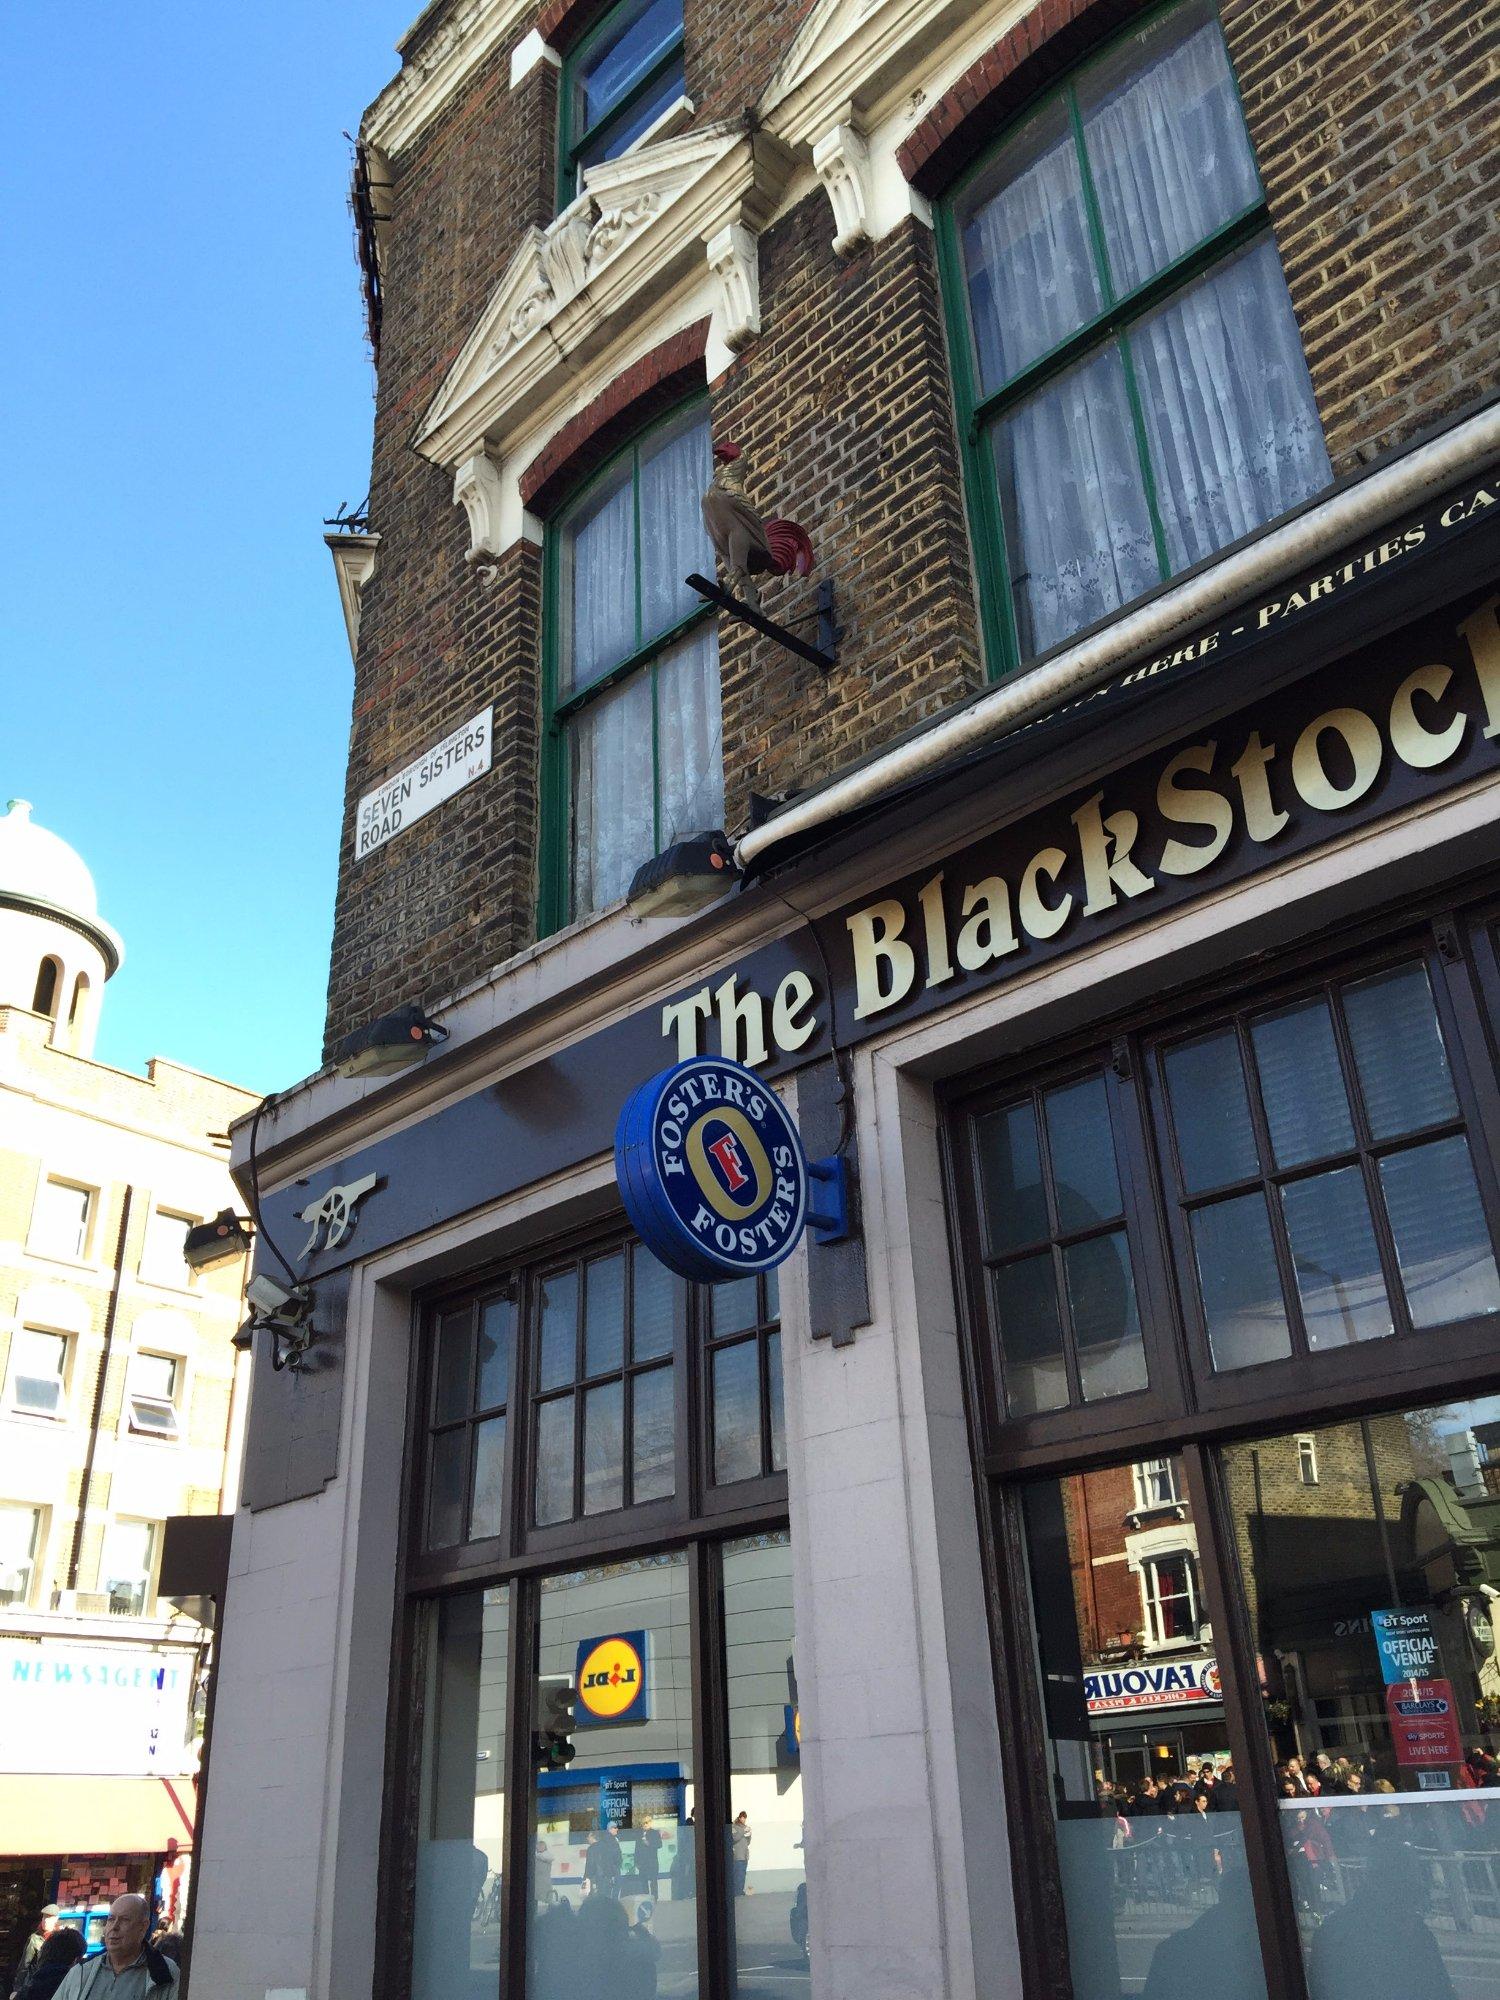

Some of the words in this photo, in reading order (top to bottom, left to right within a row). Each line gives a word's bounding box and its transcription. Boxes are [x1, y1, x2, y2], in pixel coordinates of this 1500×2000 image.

[1257, 523, 1427, 630] PARTIES
[1440, 476, 1500, 528] CA
[361, 777, 412, 829] SEVEN
[419, 725, 485, 789] SISTERS
[360, 808, 403, 853] ROAD
[661, 970, 818, 1069] The
[660, 1072, 768, 1177] FOSTER'S
[690, 1144, 796, 1256] FOSTER'S
[1383, 1615, 1399, 1628] BT
[1400, 1613, 1429, 1627] Sport
[1382, 1636, 1439, 1655] OFFICIAL
[1391, 1650, 1435, 1667] VENUE
[12, 1659, 179, 1690] NEWSAGENT
[1402, 1668, 1430, 1679] 2014/15
[1402, 1687, 1435, 1698] 204/15
[1401, 1701, 1436, 1710] BARCLAYS
[1419, 1732, 1446, 1740] SPORTS
[1409, 1746, 1426, 1756] LIVE
[1429, 1745, 1449, 1755] HERE
[614, 1780, 628, 1790] Sport
[602, 1797, 630, 1809] OFFICIAL
[605, 1807, 627, 1818] VENUE
